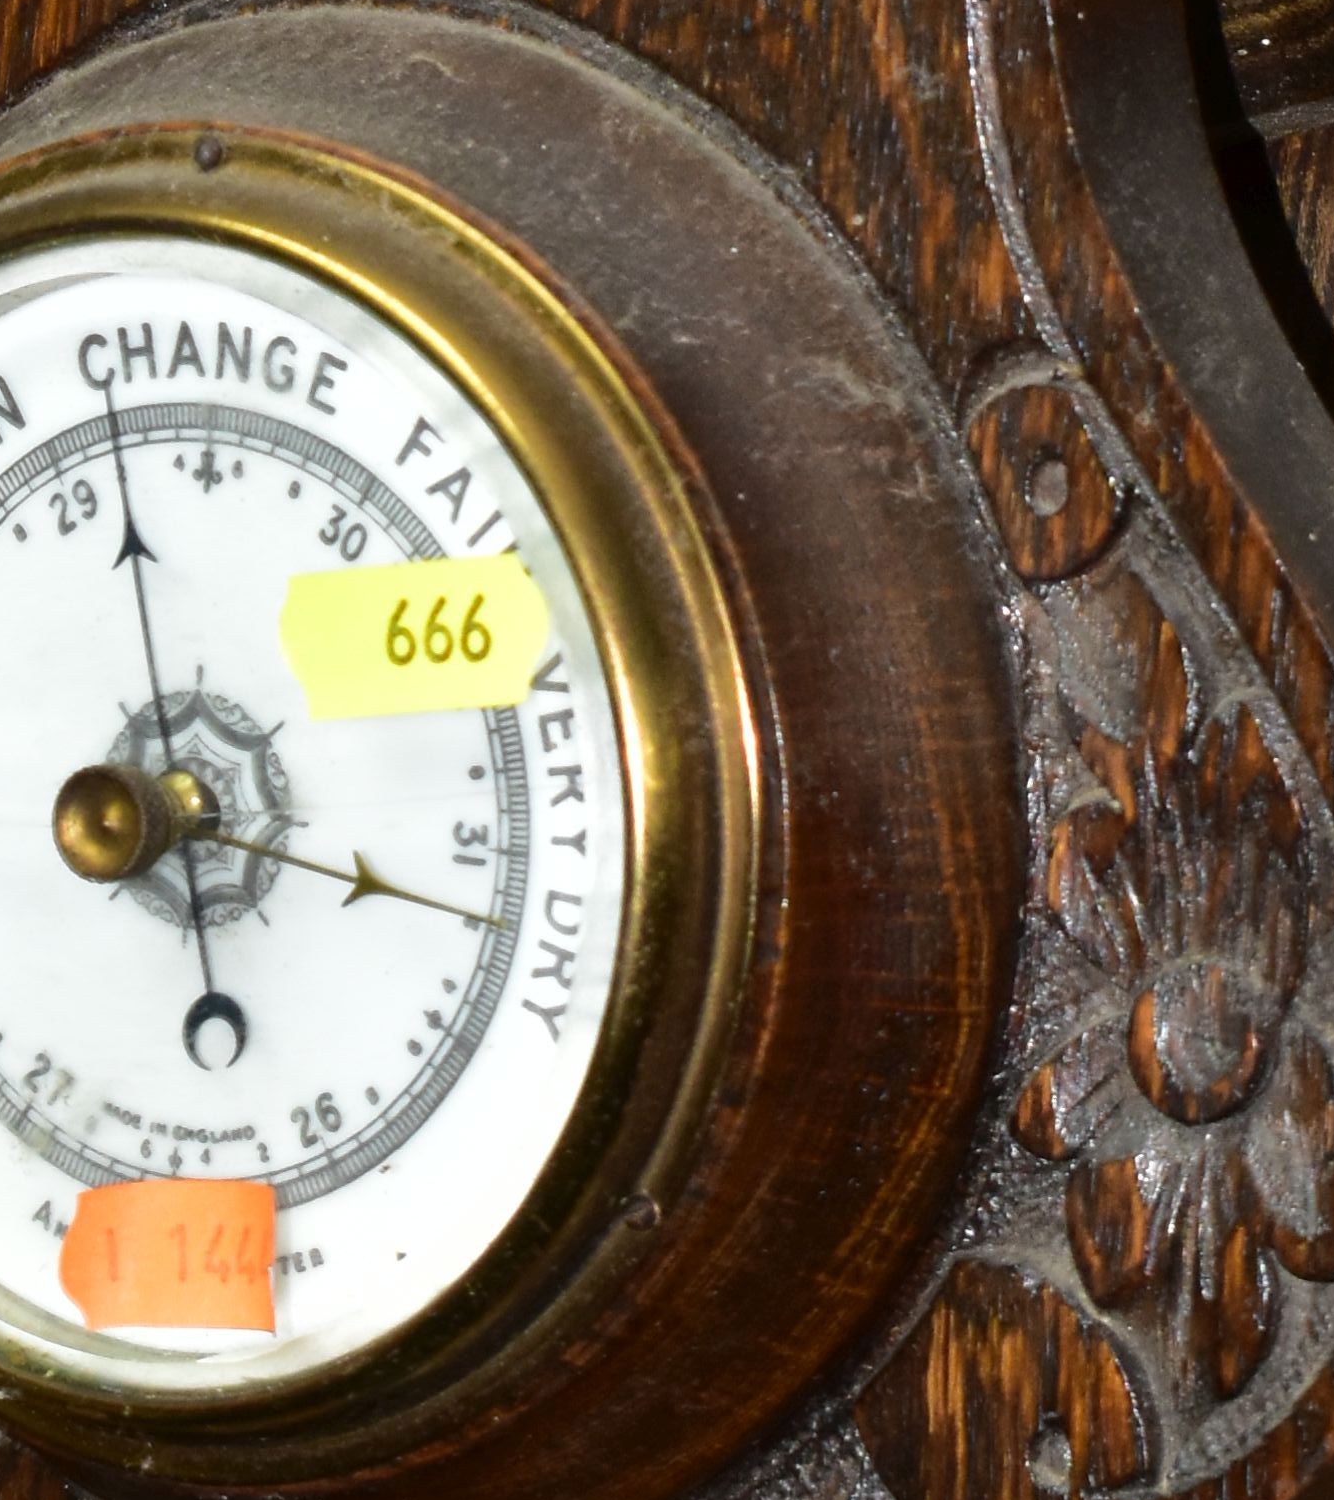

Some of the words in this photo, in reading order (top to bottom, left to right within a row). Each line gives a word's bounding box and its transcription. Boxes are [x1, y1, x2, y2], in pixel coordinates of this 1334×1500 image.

[77, 320, 349, 416] CHANGE
[47, 478, 98, 536] 29
[394, 415, 530, 576] FAI
[317, 503, 368, 562] 30
[385, 593, 493, 667] 666
[451, 820, 489, 867] 31
[23, 1052, 75, 1107] 27
[149, 1121, 168, 1137] IN
[290, 1091, 343, 1149] 26
